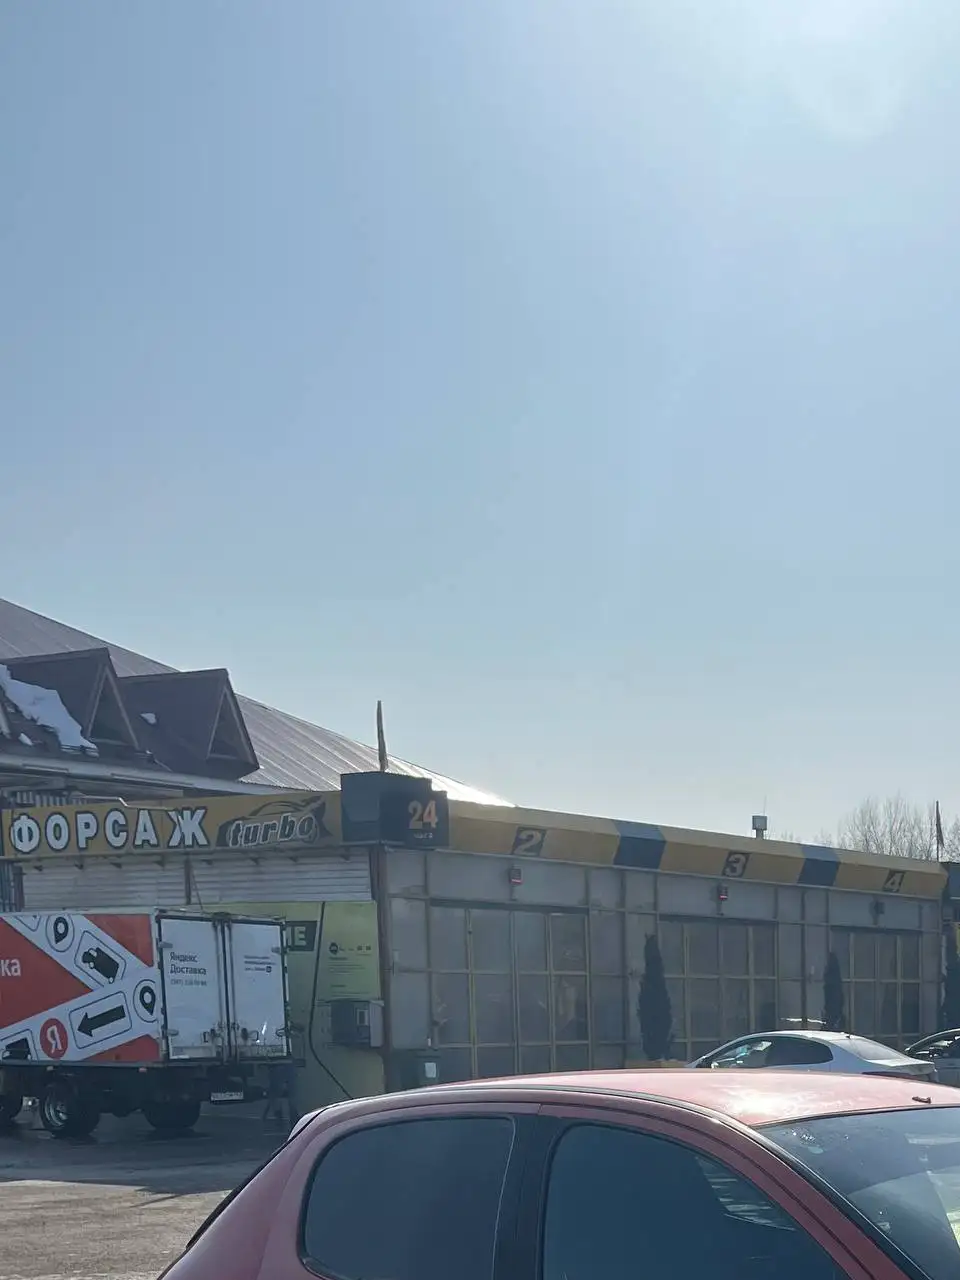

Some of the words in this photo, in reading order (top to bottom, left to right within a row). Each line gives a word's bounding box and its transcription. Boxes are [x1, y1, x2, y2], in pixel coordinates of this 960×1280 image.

[408, 799, 438, 829] 24
[10, 807, 209, 853] ФОРСАЖ
[227, 812, 317, 848] turbo
[516, 829, 543, 855] 2
[726, 853, 747, 876] 3
[169, 963, 207, 975] Доставка
[46, 1025, 63, 1053] Я
